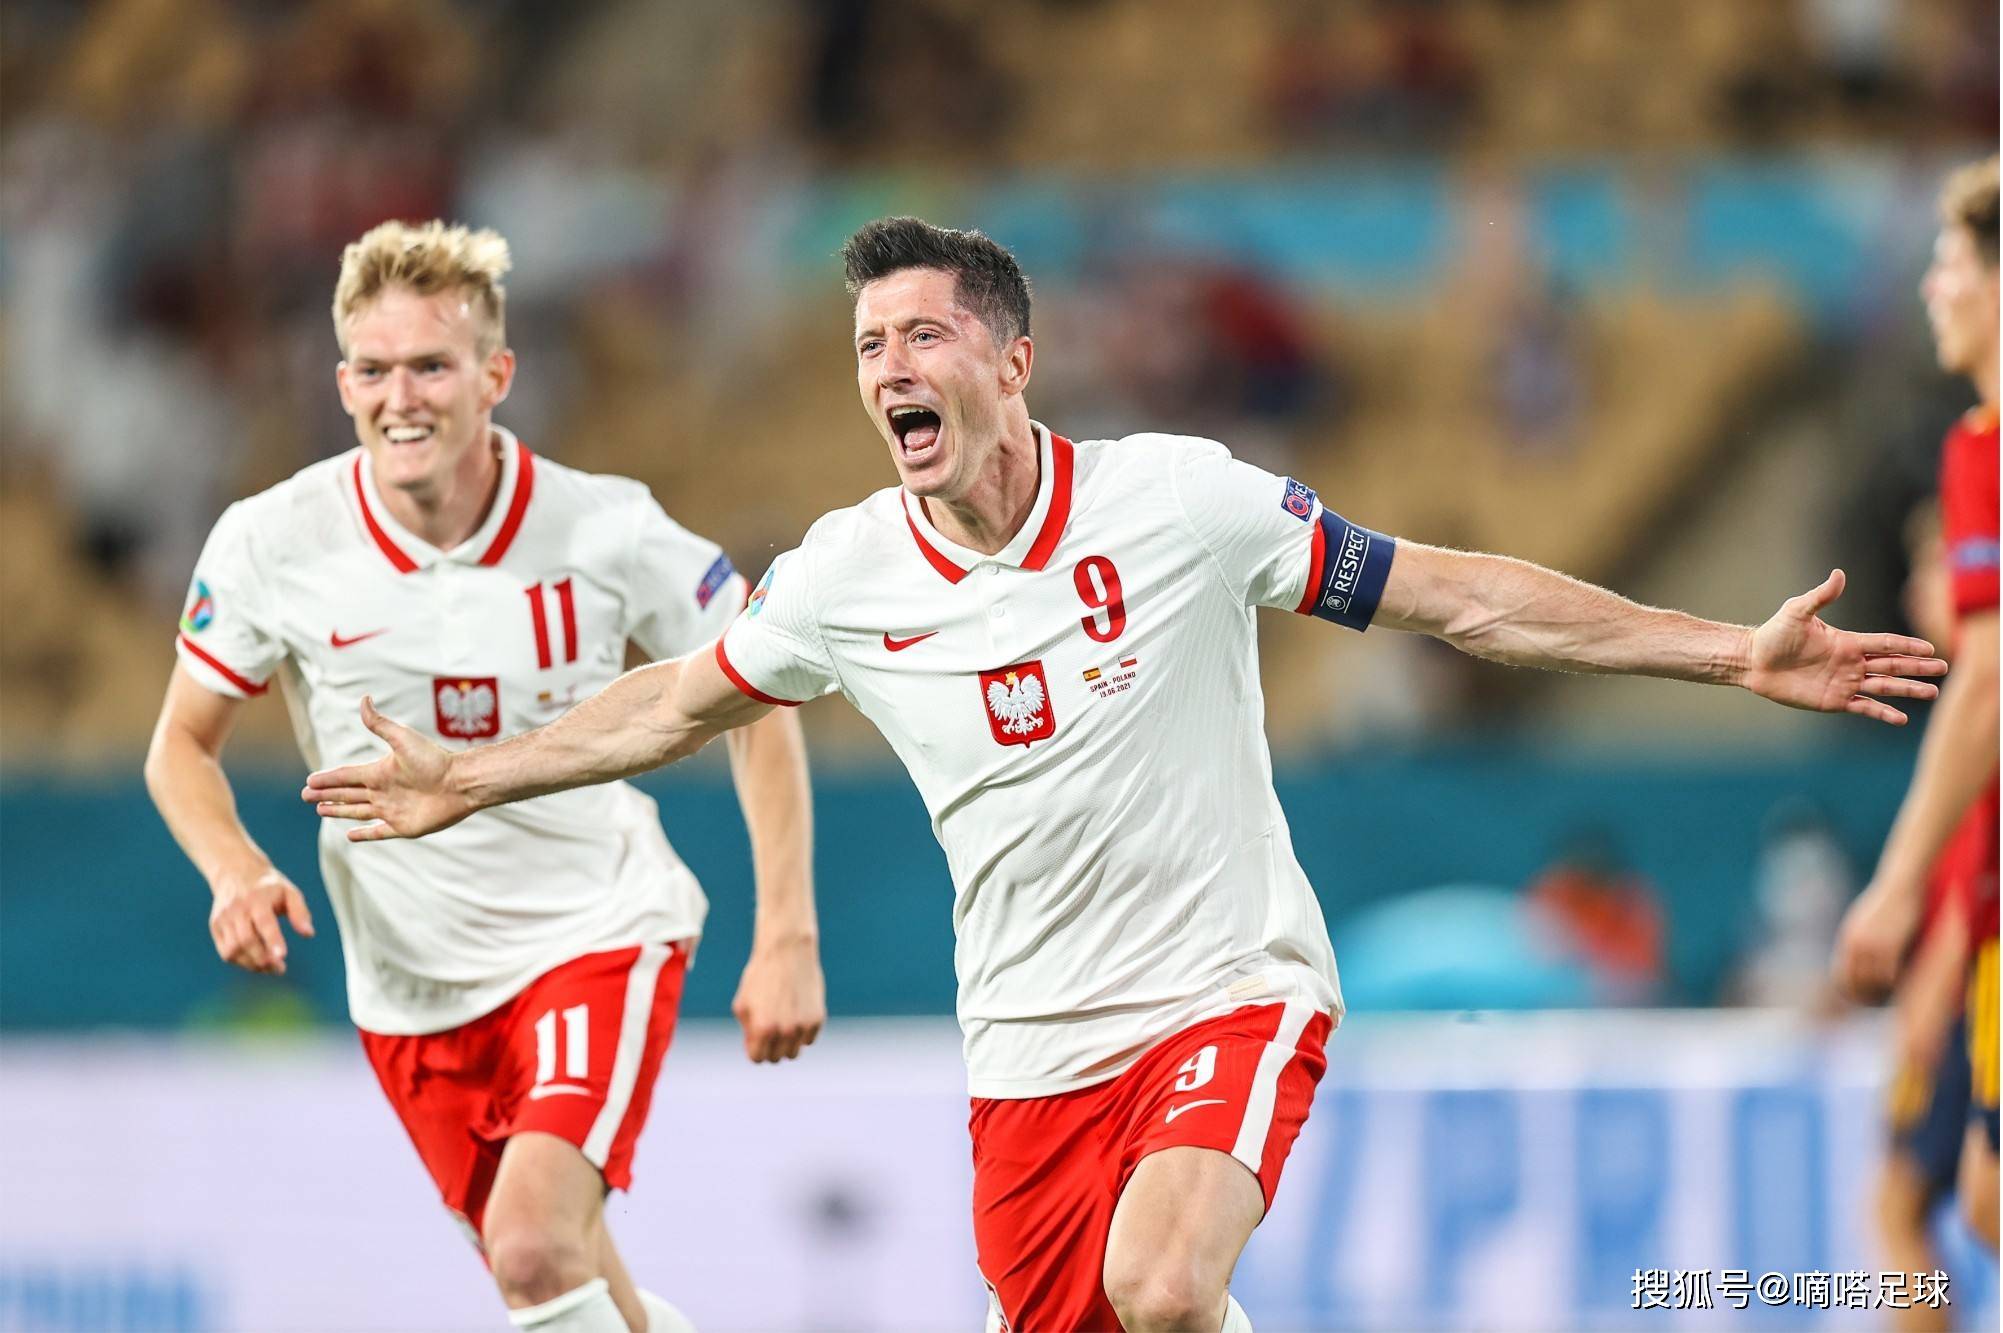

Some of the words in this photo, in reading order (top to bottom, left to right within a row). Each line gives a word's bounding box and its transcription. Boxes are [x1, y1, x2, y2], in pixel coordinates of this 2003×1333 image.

[1335, 529, 1366, 592] RESPECT
[524, 577, 578, 671] 11
[1073, 555, 1127, 643] 9
[1090, 681, 1108, 692] SPAIN
[1112, 671, 1136, 683] POLAND
[534, 1003, 589, 1085] 11
[1174, 1045, 1218, 1092] 9
